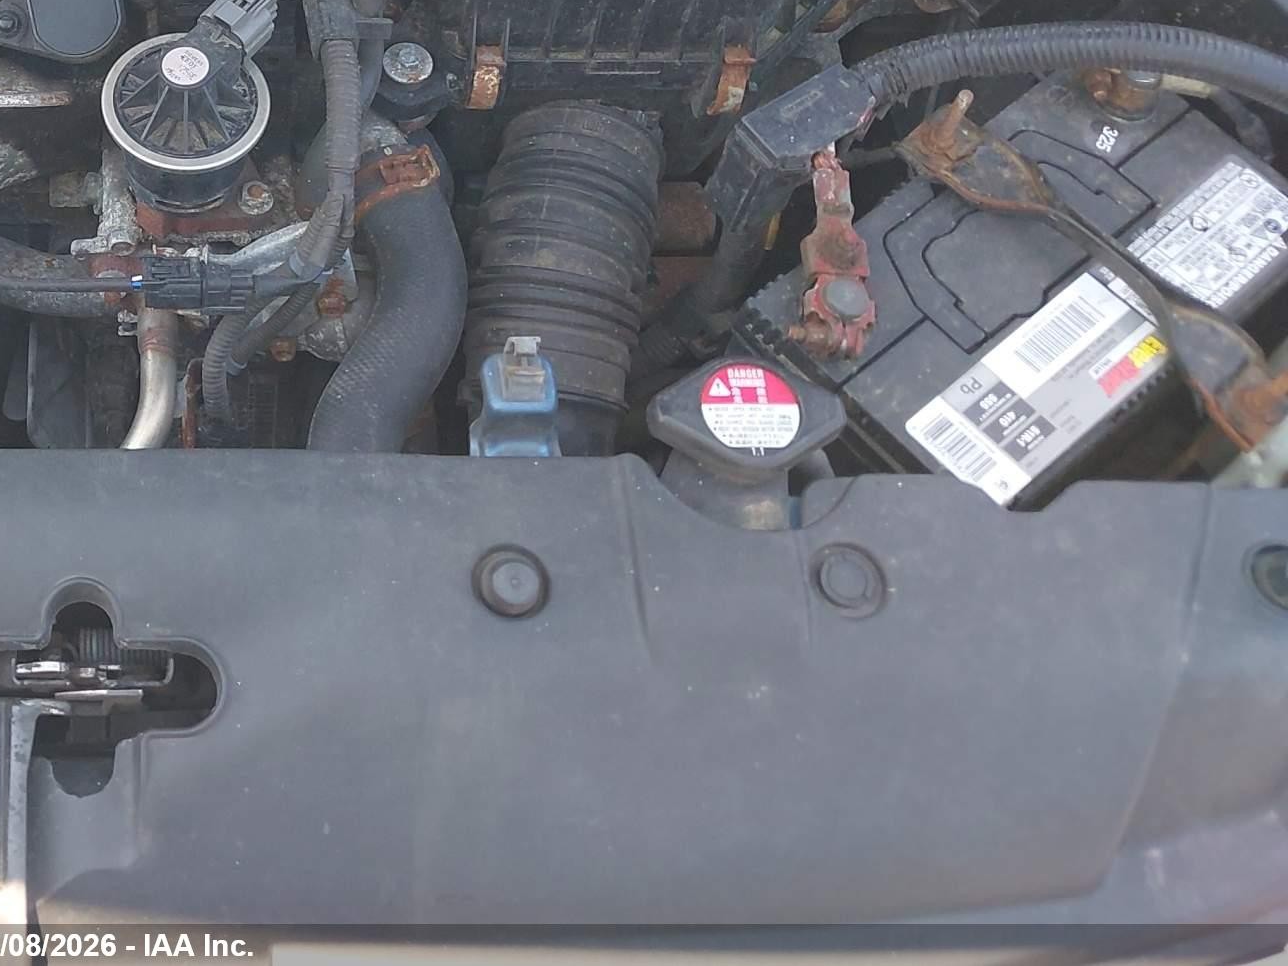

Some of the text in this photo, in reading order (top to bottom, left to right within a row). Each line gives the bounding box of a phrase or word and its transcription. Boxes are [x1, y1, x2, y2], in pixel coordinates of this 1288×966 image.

[1096, 125, 1119, 153] 3/25
[727, 368, 764, 379] DANGER
[960, 377, 983, 394] Pb
